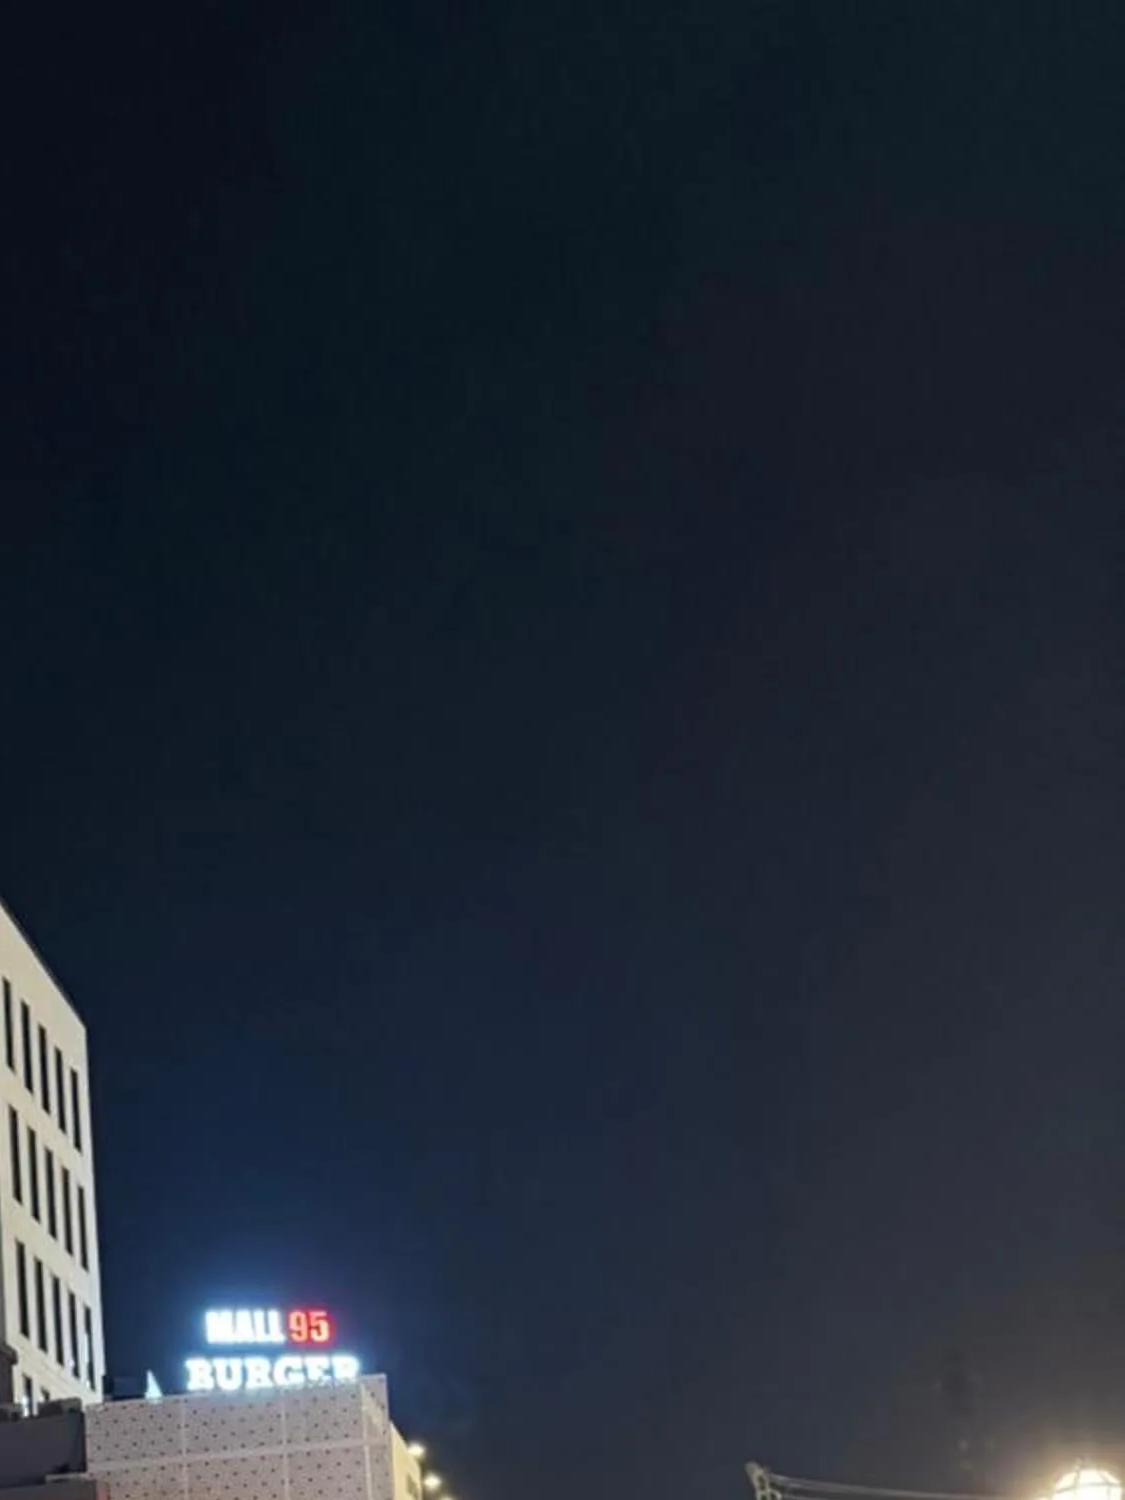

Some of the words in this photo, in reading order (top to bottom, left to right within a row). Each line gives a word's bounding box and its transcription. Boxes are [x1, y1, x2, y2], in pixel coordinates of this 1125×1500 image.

[205, 1308, 286, 1344] MALL
[288, 1310, 331, 1343] 95
[185, 1354, 360, 1391] BURGER
